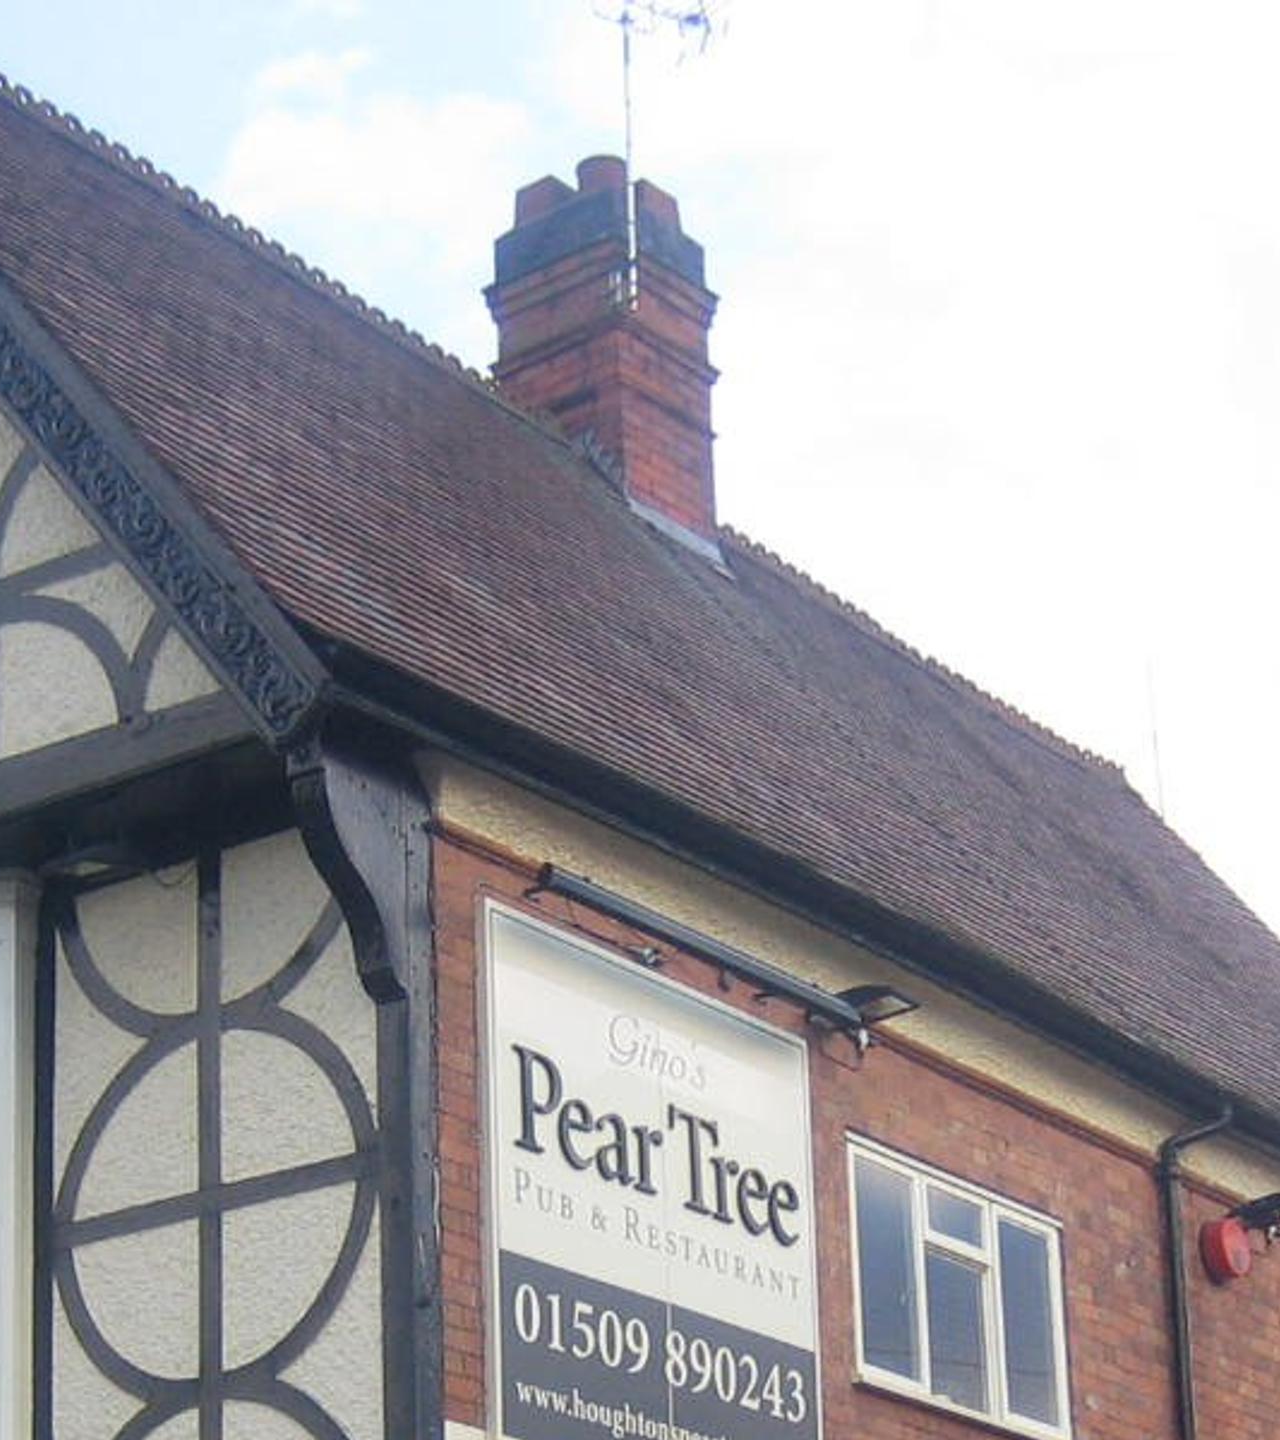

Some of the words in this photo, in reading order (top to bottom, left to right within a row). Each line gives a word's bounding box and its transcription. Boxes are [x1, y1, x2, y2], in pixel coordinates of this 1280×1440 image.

[608, 1014, 707, 1092] Gino's
[511, 1044, 663, 1196] Pear
[668, 1103, 799, 1246] Tree
[514, 1167, 574, 1221] PUB
[591, 1206, 606, 1231] &
[625, 1205, 801, 1300] RESTAURANT
[515, 1283, 650, 1373] 01509
[665, 1330, 807, 1423] 890243
